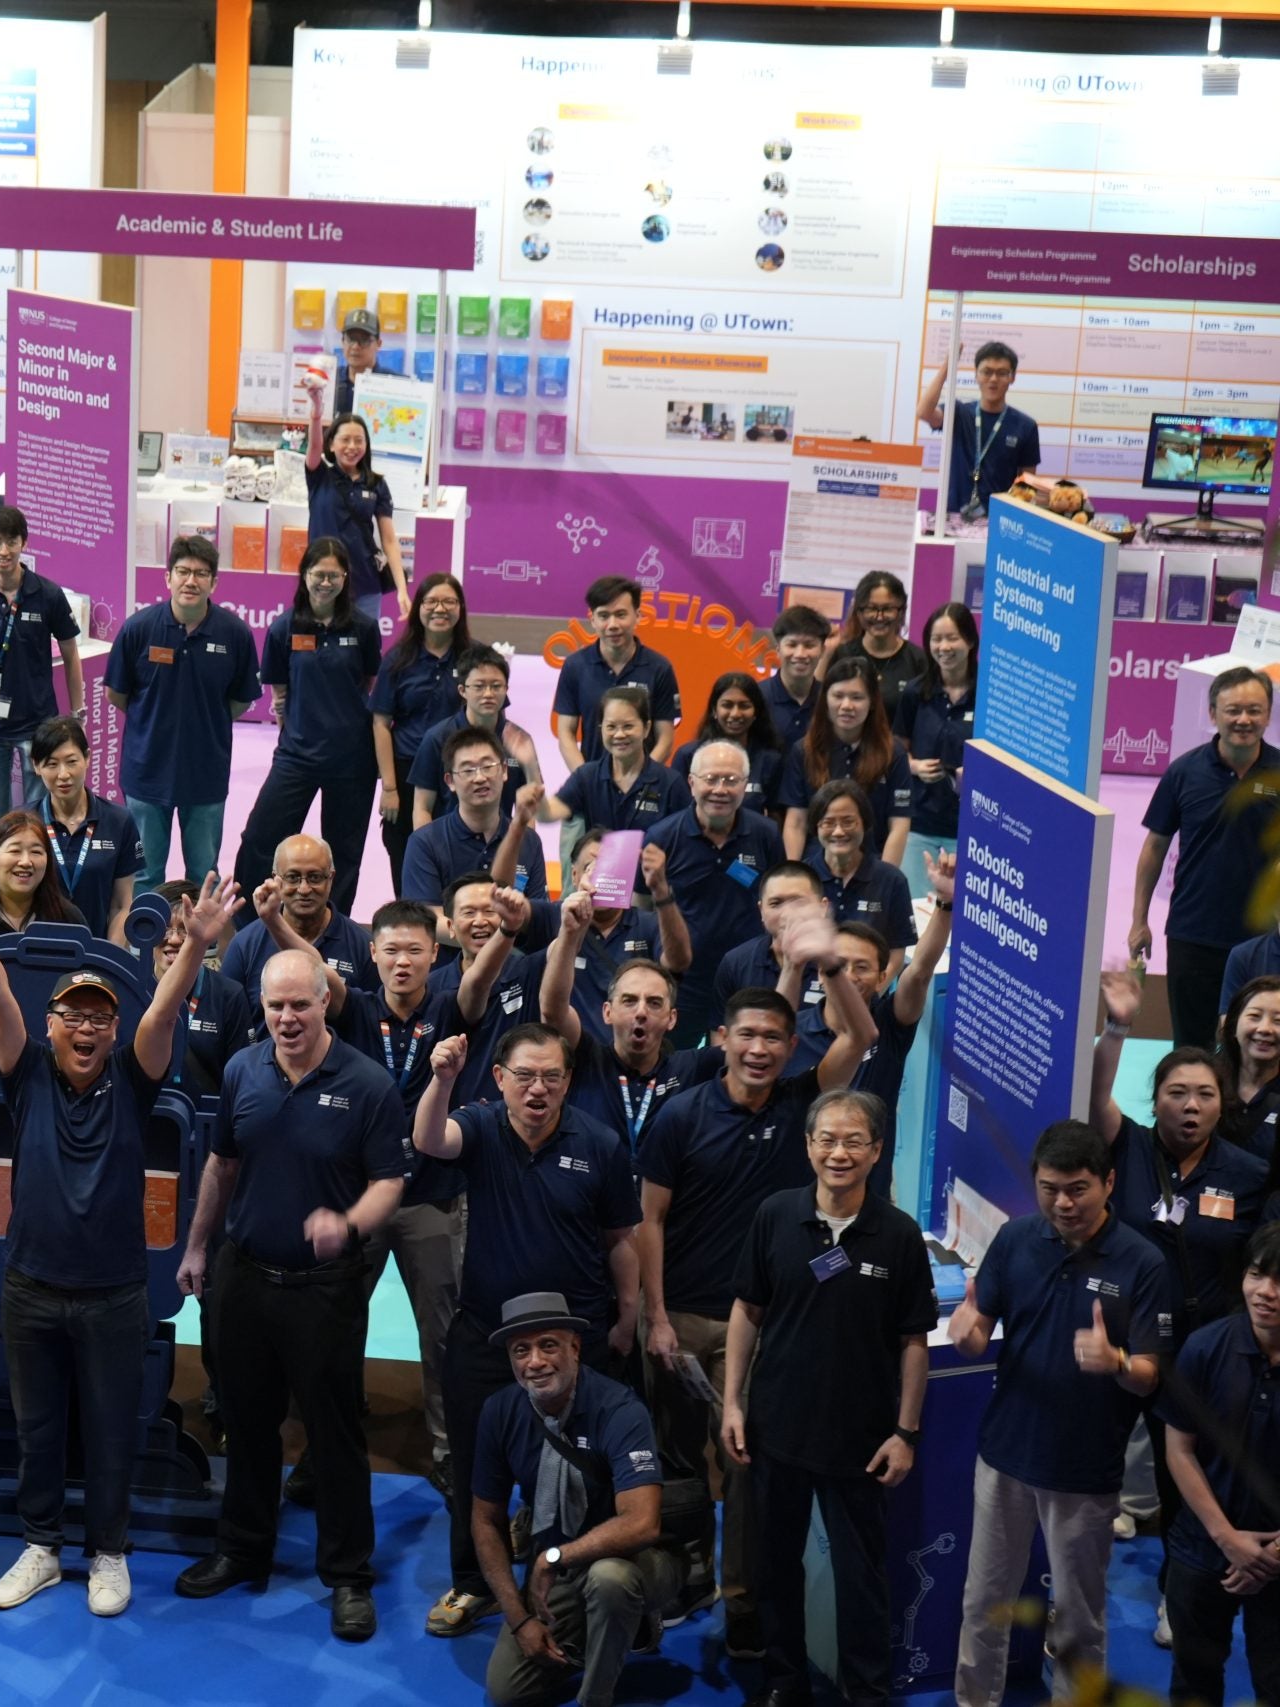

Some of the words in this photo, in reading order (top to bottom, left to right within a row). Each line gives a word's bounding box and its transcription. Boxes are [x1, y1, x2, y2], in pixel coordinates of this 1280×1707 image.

[1052, 75, 1071, 95] @
[116, 214, 206, 235] Academic
[211, 218, 225, 235] &
[230, 219, 302, 240] Student
[307, 222, 343, 242] Life
[952, 246, 1003, 259] Engineering
[1005, 248, 1043, 259] Scholars
[1046, 251, 1097, 262] Programme
[987, 270, 1017, 282] Design
[1020, 272, 1057, 282] Scholars
[1060, 273, 1110, 284] Programme
[1128, 253, 1256, 280] Scholarships
[30, 309, 45, 320] NUS
[594, 308, 694, 330] Happening
[700, 313, 718, 332] @
[725, 315, 794, 331] UTown:
[942, 310, 1003, 321] Prrammes
[1089, 316, 1109, 327] 9am
[1125, 317, 1150, 328] 10am
[1199, 321, 1221, 332] 1pm
[1233, 322, 1255, 333] 2pm
[18, 338, 65, 361] Second
[68, 347, 104, 370] Major
[107, 355, 116, 371] &
[609, 354, 658, 364] Innovation
[670, 356, 711, 365] Robotics
[715, 358, 762, 367] Showcase
[18, 358, 54, 378] Minor
[58, 365, 69, 381] in
[18, 377, 83, 404] Innovation
[86, 393, 109, 408] and
[1083, 381, 1108, 392] 10am
[1123, 385, 1149, 395] 11am
[1193, 389, 1215, 399] 2pm
[1226, 390, 1248, 401] 3pm
[18, 396, 60, 421] Design
[1155, 415, 1197, 425] ORIENTATION
[1077, 434, 1103, 445] 11am
[1116, 436, 1144, 447] 12pm
[813, 465, 898, 482] SCHOLARSHIPS
[1008, 521, 1024, 535] NUS
[997, 553, 1050, 593] Industrial
[1052, 582, 1075, 604] and
[995, 578, 1044, 615] Systems
[993, 602, 1061, 653] Engineering
[92, 676, 103, 725] Minor
[108, 703, 119, 734] ond
[92, 729, 103, 745] in
[92, 749, 103, 796] Innov
[105, 738, 119, 785] Major
[107, 791, 117, 800] &
[981, 795, 999, 816] NUS
[51, 838, 59, 852] NUS
[56, 852, 65, 865] IDP
[78, 850, 86, 865] NUS
[968, 836, 1024, 890] Robotics
[965, 871, 989, 900] and
[992, 882, 1047, 936] Machine
[964, 895, 1038, 962] Intelligence
[961, 941, 978, 960] Robots
[979, 955, 987, 966] are
[987, 961, 1010, 983] changing
[1010, 977, 1033, 998] everyday
[1043, 999, 1064, 1020] offering
